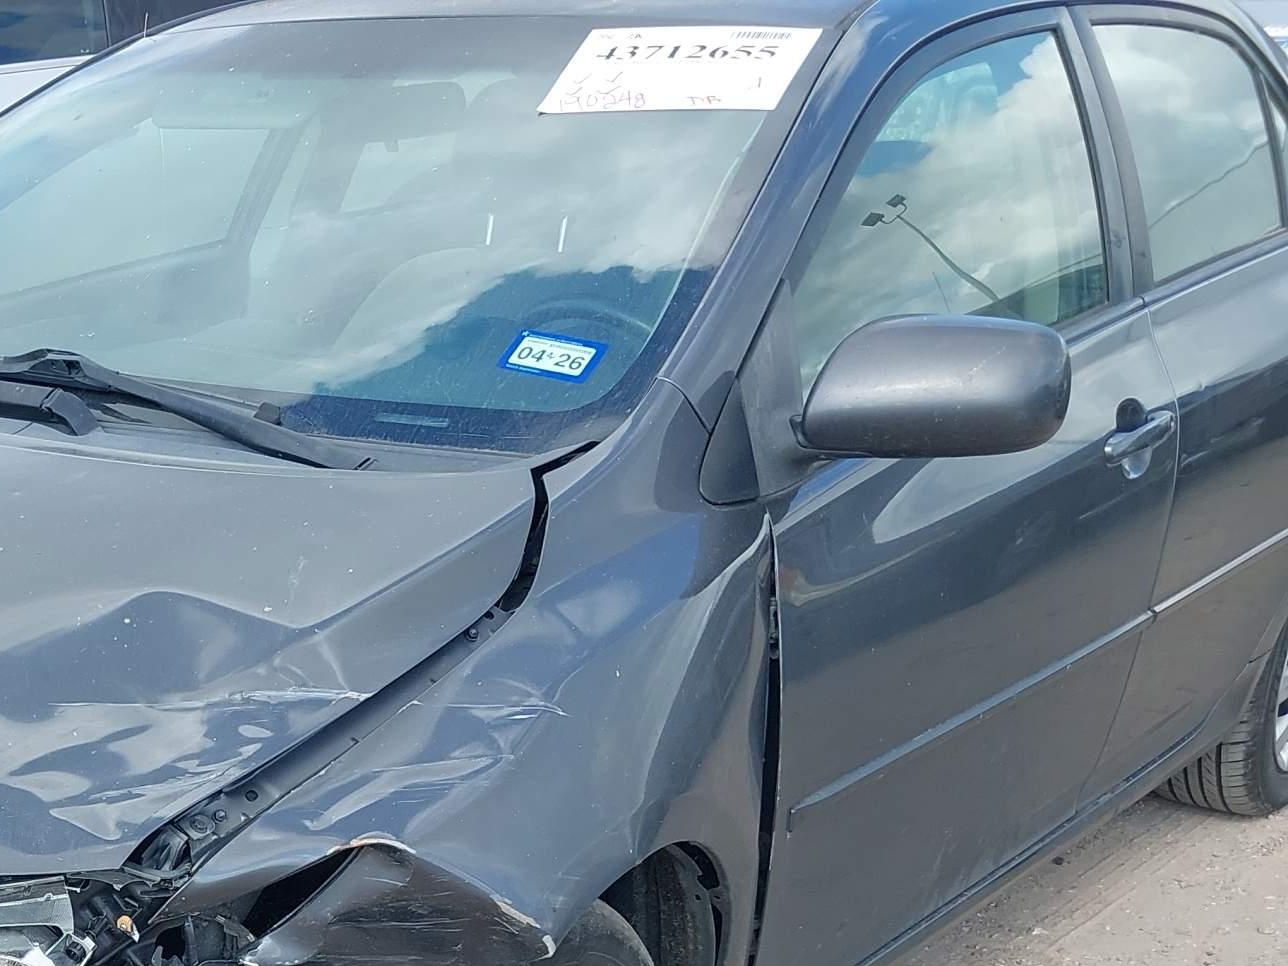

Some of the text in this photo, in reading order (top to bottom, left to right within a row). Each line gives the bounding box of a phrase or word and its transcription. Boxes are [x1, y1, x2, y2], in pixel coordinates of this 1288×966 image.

[596, 44, 780, 60] 43712655
[517, 346, 547, 362] 04
[553, 353, 586, 371] 26
